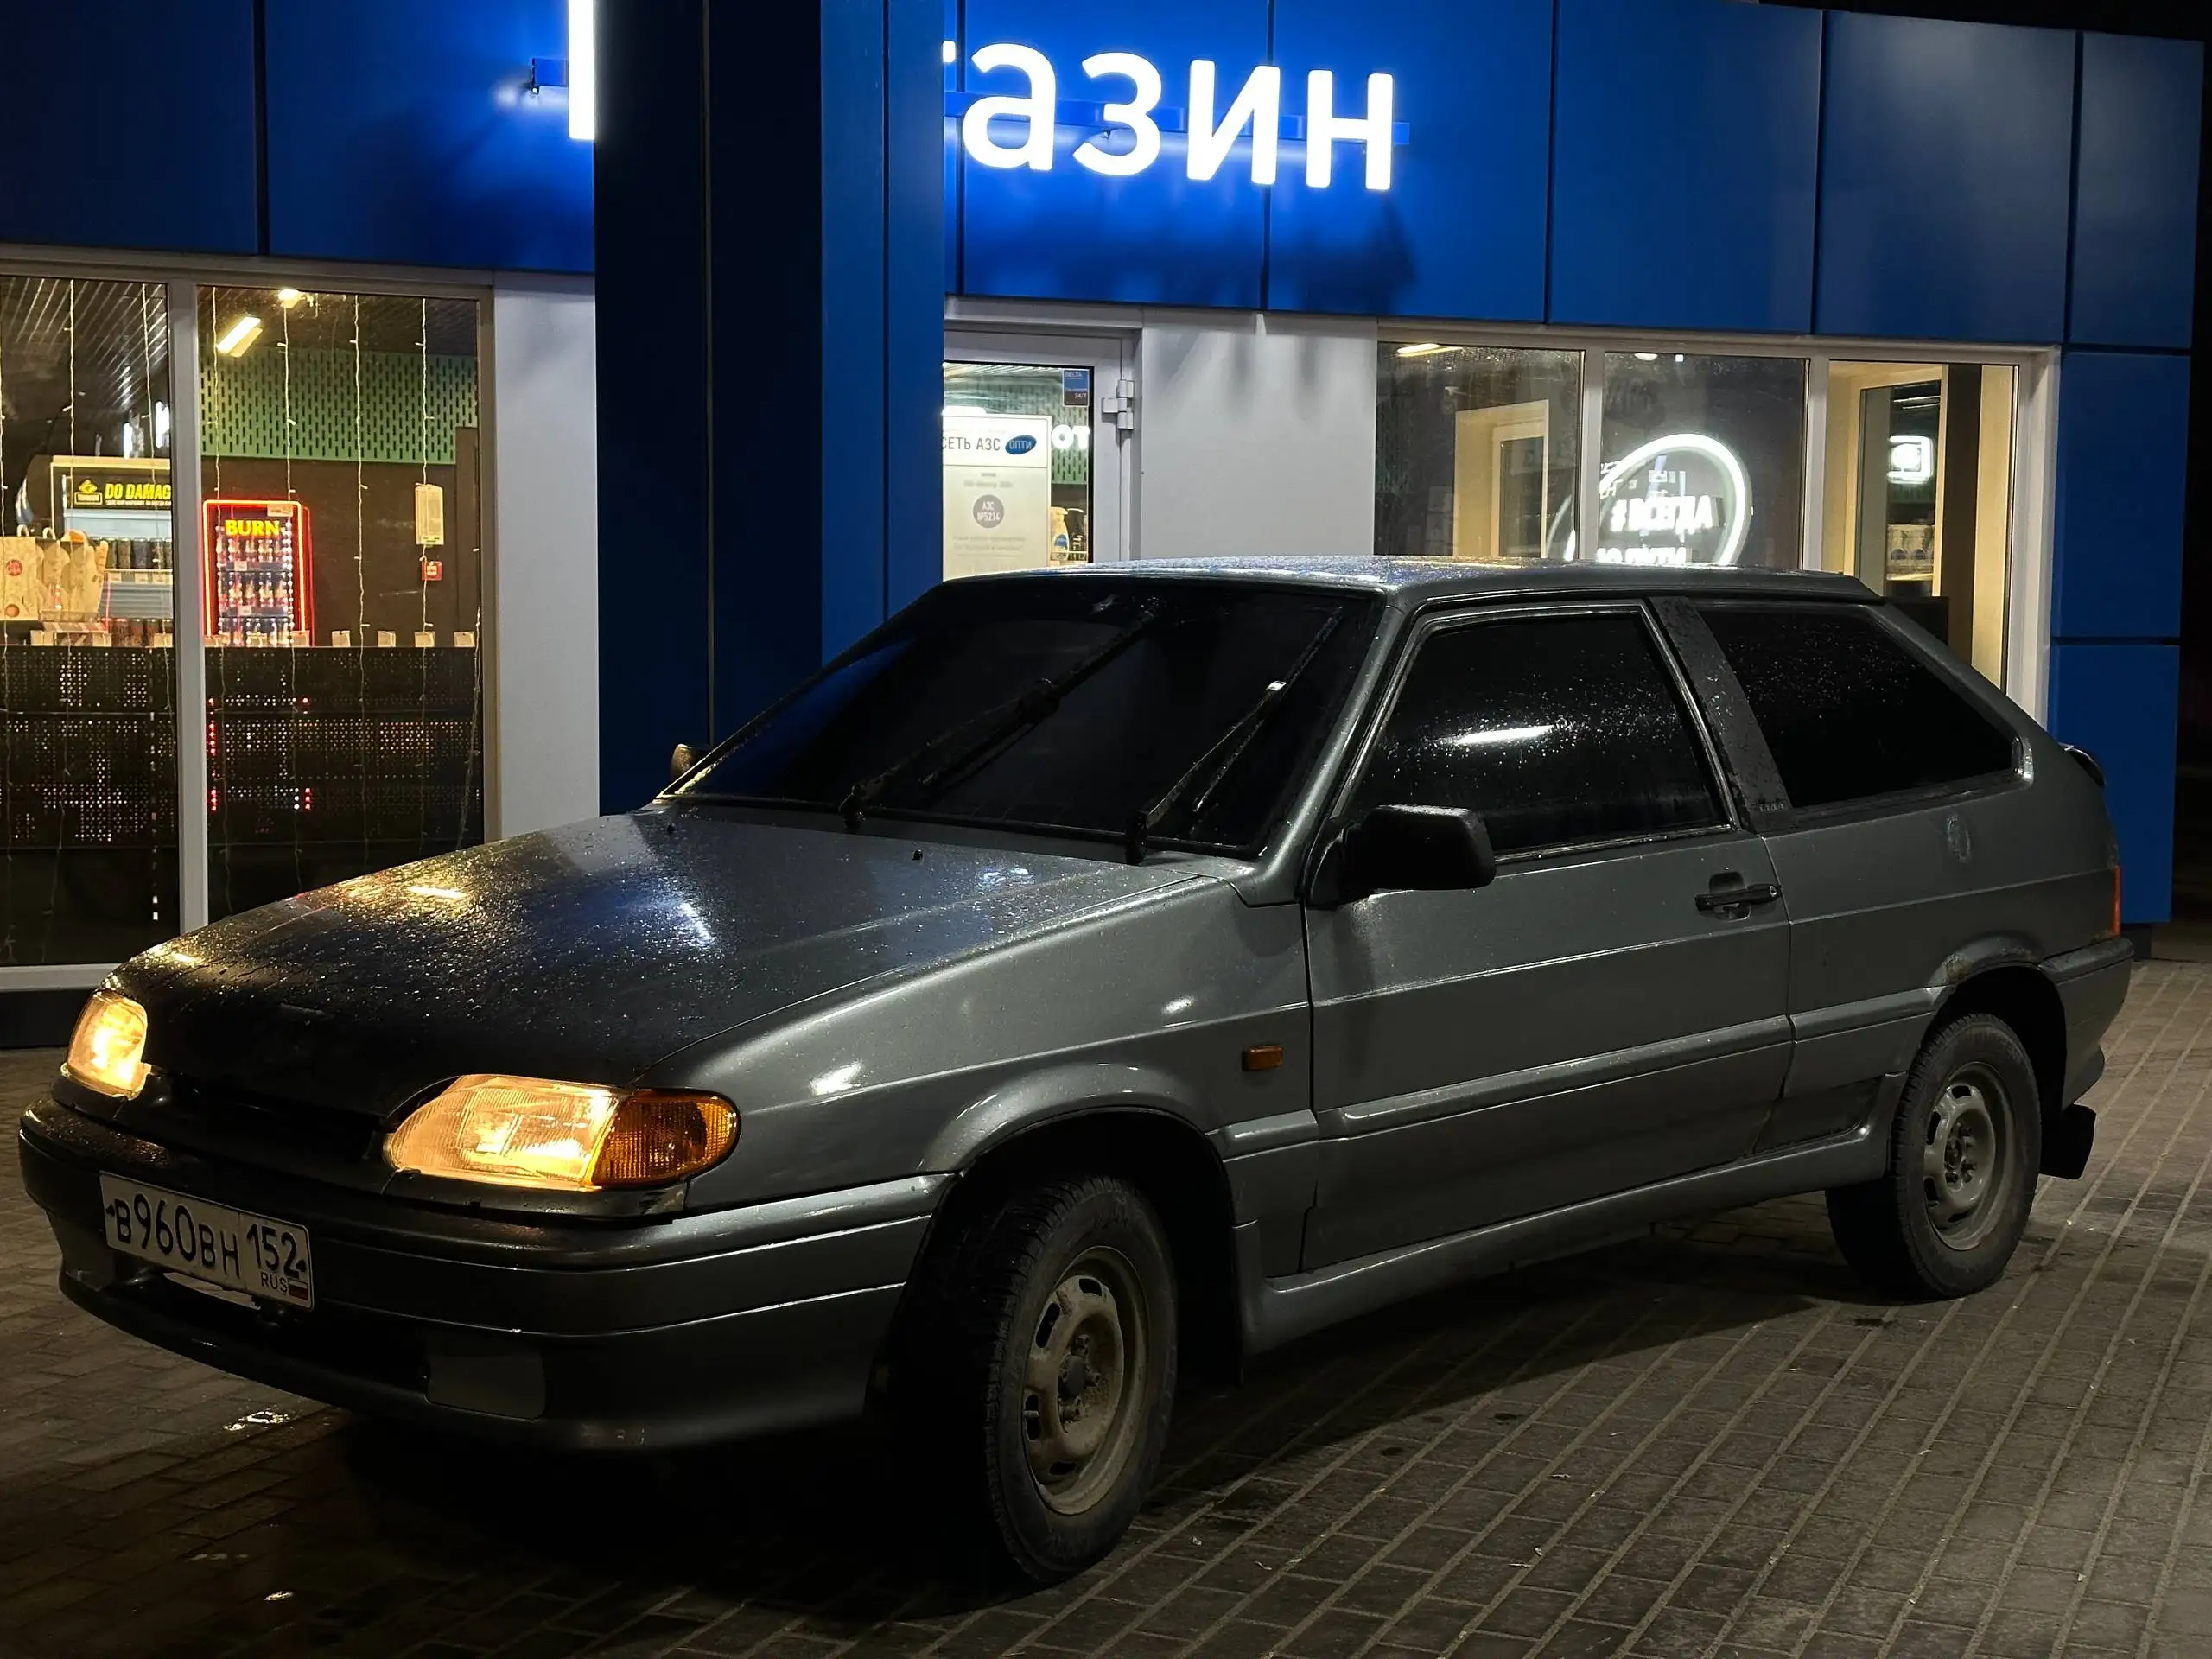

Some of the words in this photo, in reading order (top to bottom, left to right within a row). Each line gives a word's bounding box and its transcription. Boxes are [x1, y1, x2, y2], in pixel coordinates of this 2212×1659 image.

[943, 41, 1394, 191] азин
[976, 437, 1001, 451] АЗС
[105, 483, 124, 499] DO
[224, 519, 281, 537] BURN
[246, 1223, 299, 1278] 152
[261, 1271, 289, 1294] RUS
